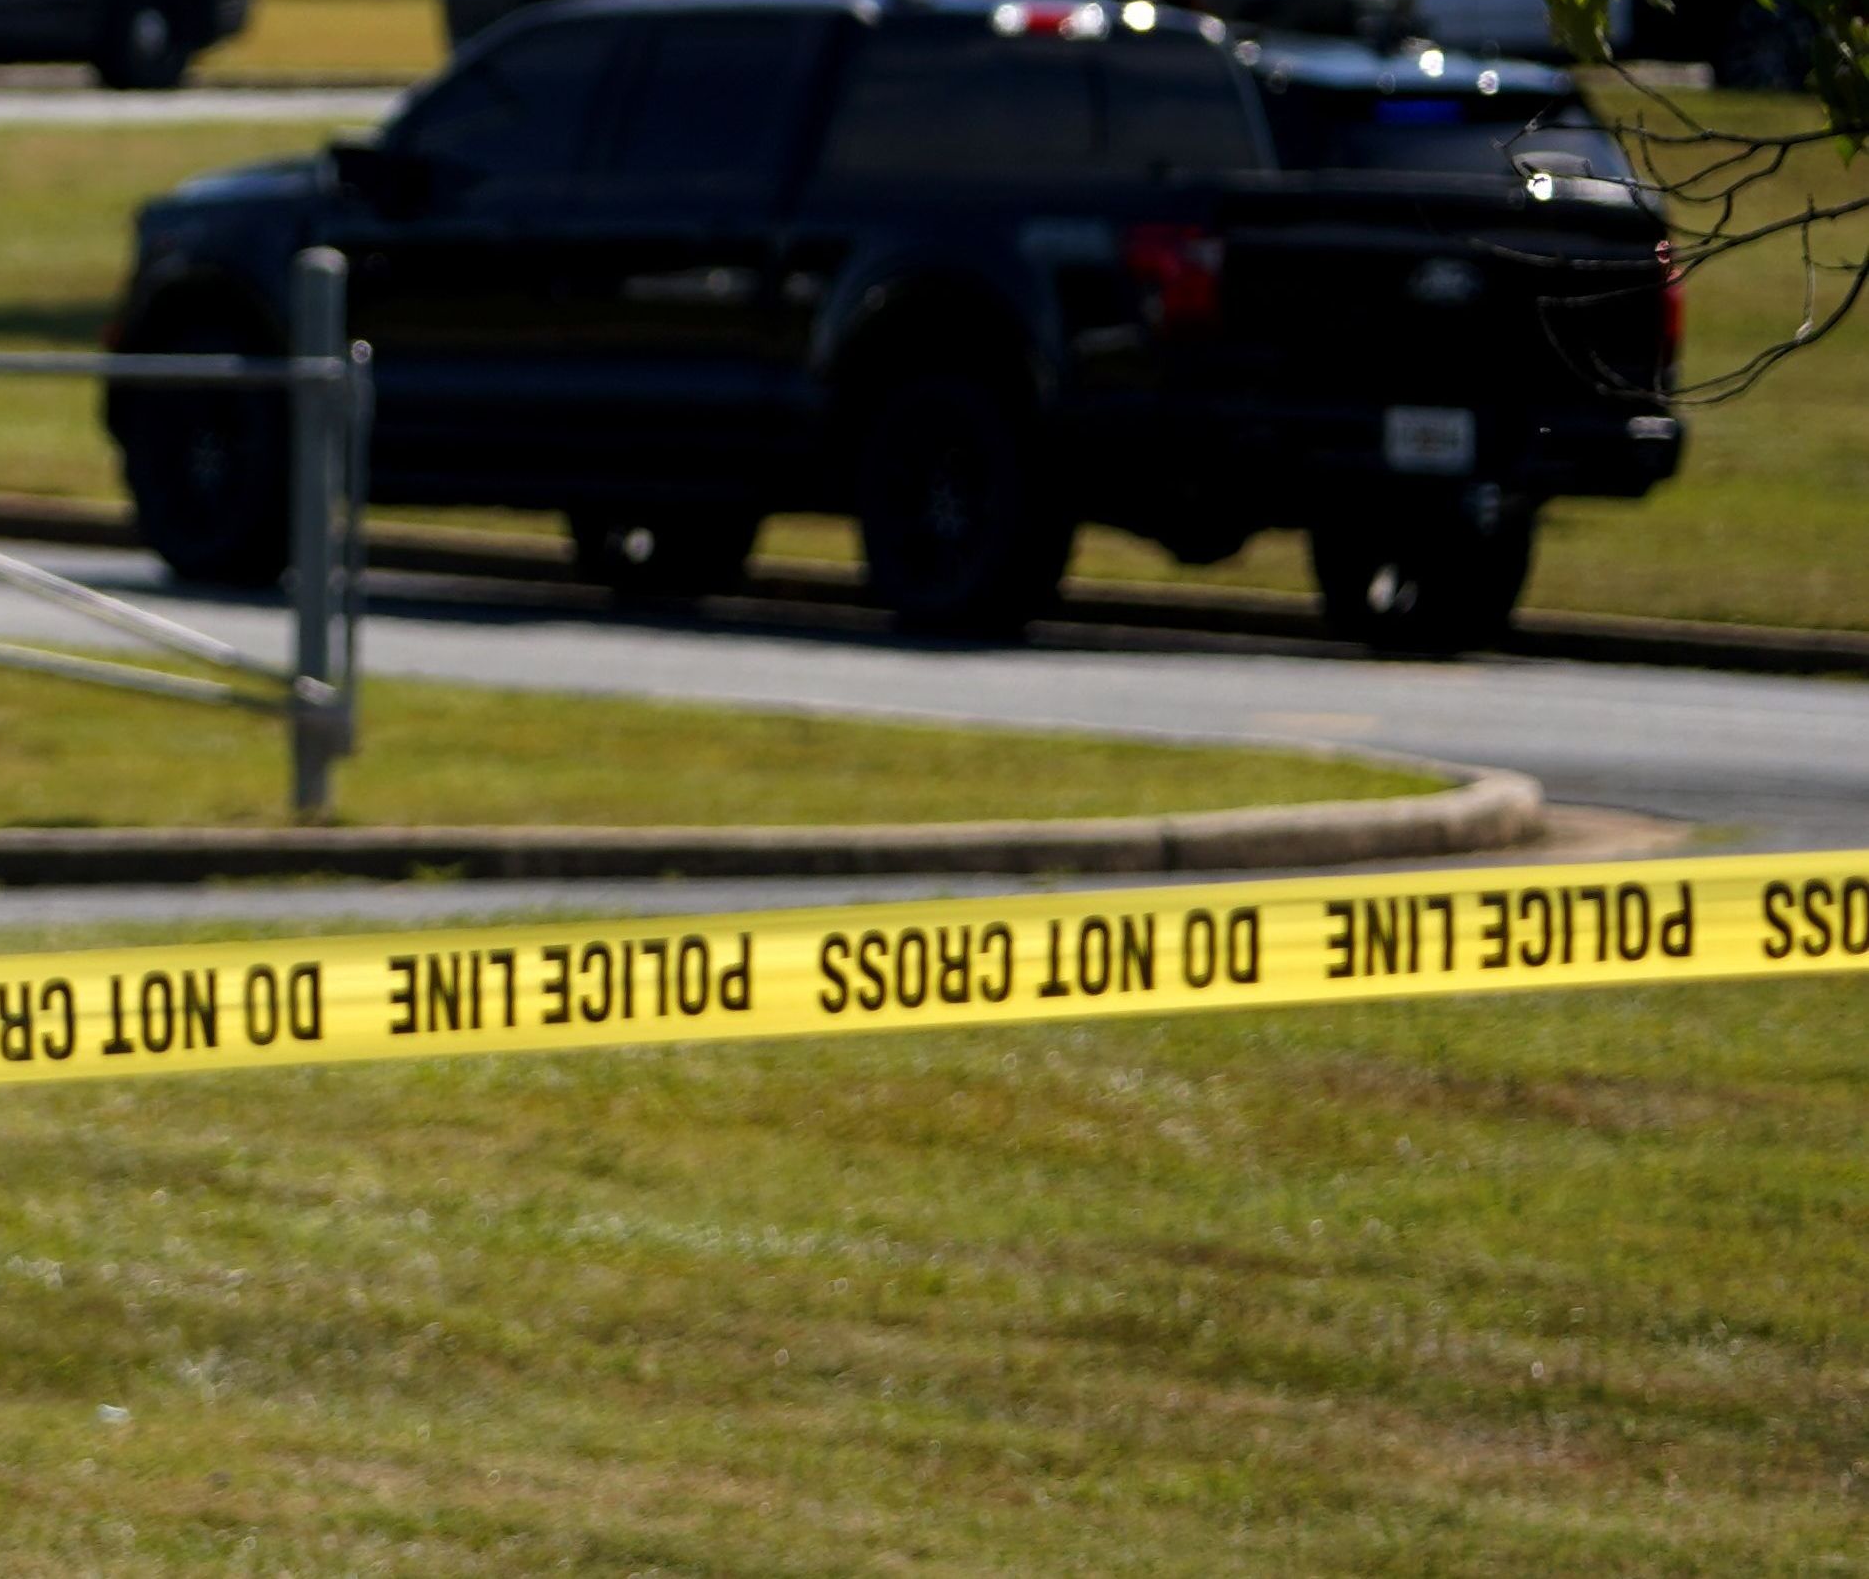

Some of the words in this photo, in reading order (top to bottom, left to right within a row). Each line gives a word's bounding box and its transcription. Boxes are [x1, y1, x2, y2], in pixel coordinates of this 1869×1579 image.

[1038, 915, 1154, 998] NOT
[1184, 907, 1259, 989] DO
[1327, 895, 1454, 979] LINE
[1481, 882, 1693, 969] POLICE
[245, 963, 321, 1046] DO
[389, 950, 515, 1035] LINE
[543, 933, 751, 1025] POLICE
[820, 923, 1013, 1014] CROSS
[102, 970, 217, 1055] NOT
